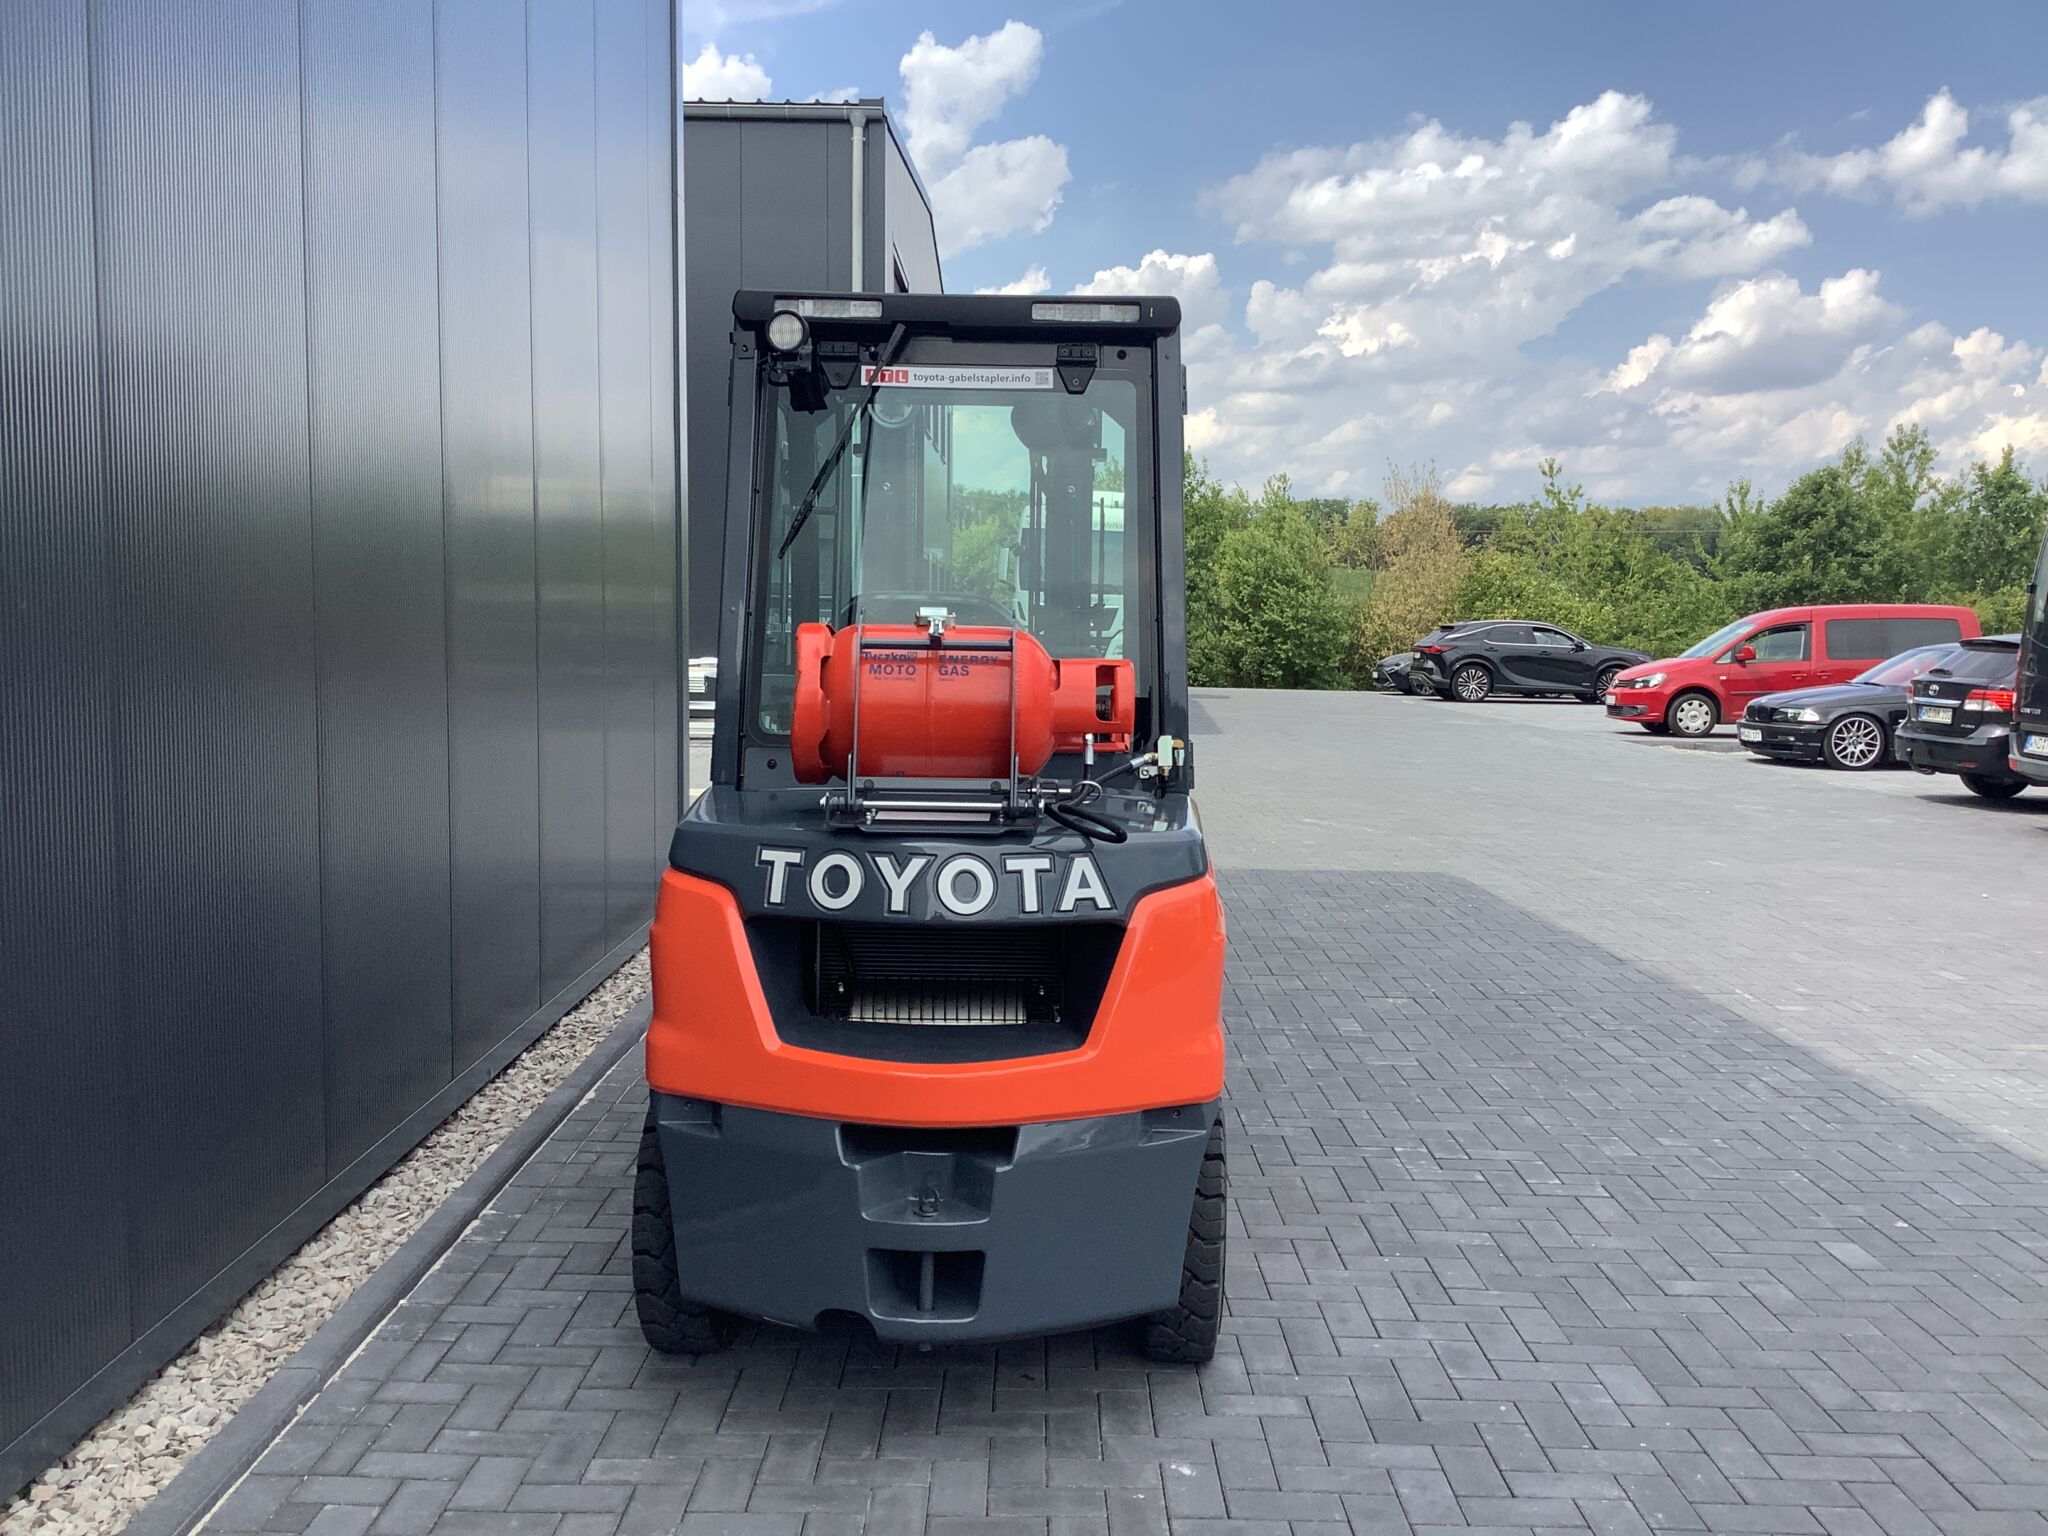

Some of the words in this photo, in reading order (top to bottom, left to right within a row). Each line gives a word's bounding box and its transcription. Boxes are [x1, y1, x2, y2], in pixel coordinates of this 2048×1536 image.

[866, 369, 908, 383] TL
[913, 372, 1031, 384] toyota-gabelstapler.info
[869, 664, 916, 675] MOTO
[938, 665, 970, 676] GAS
[758, 848, 1118, 916] TOYOTA
